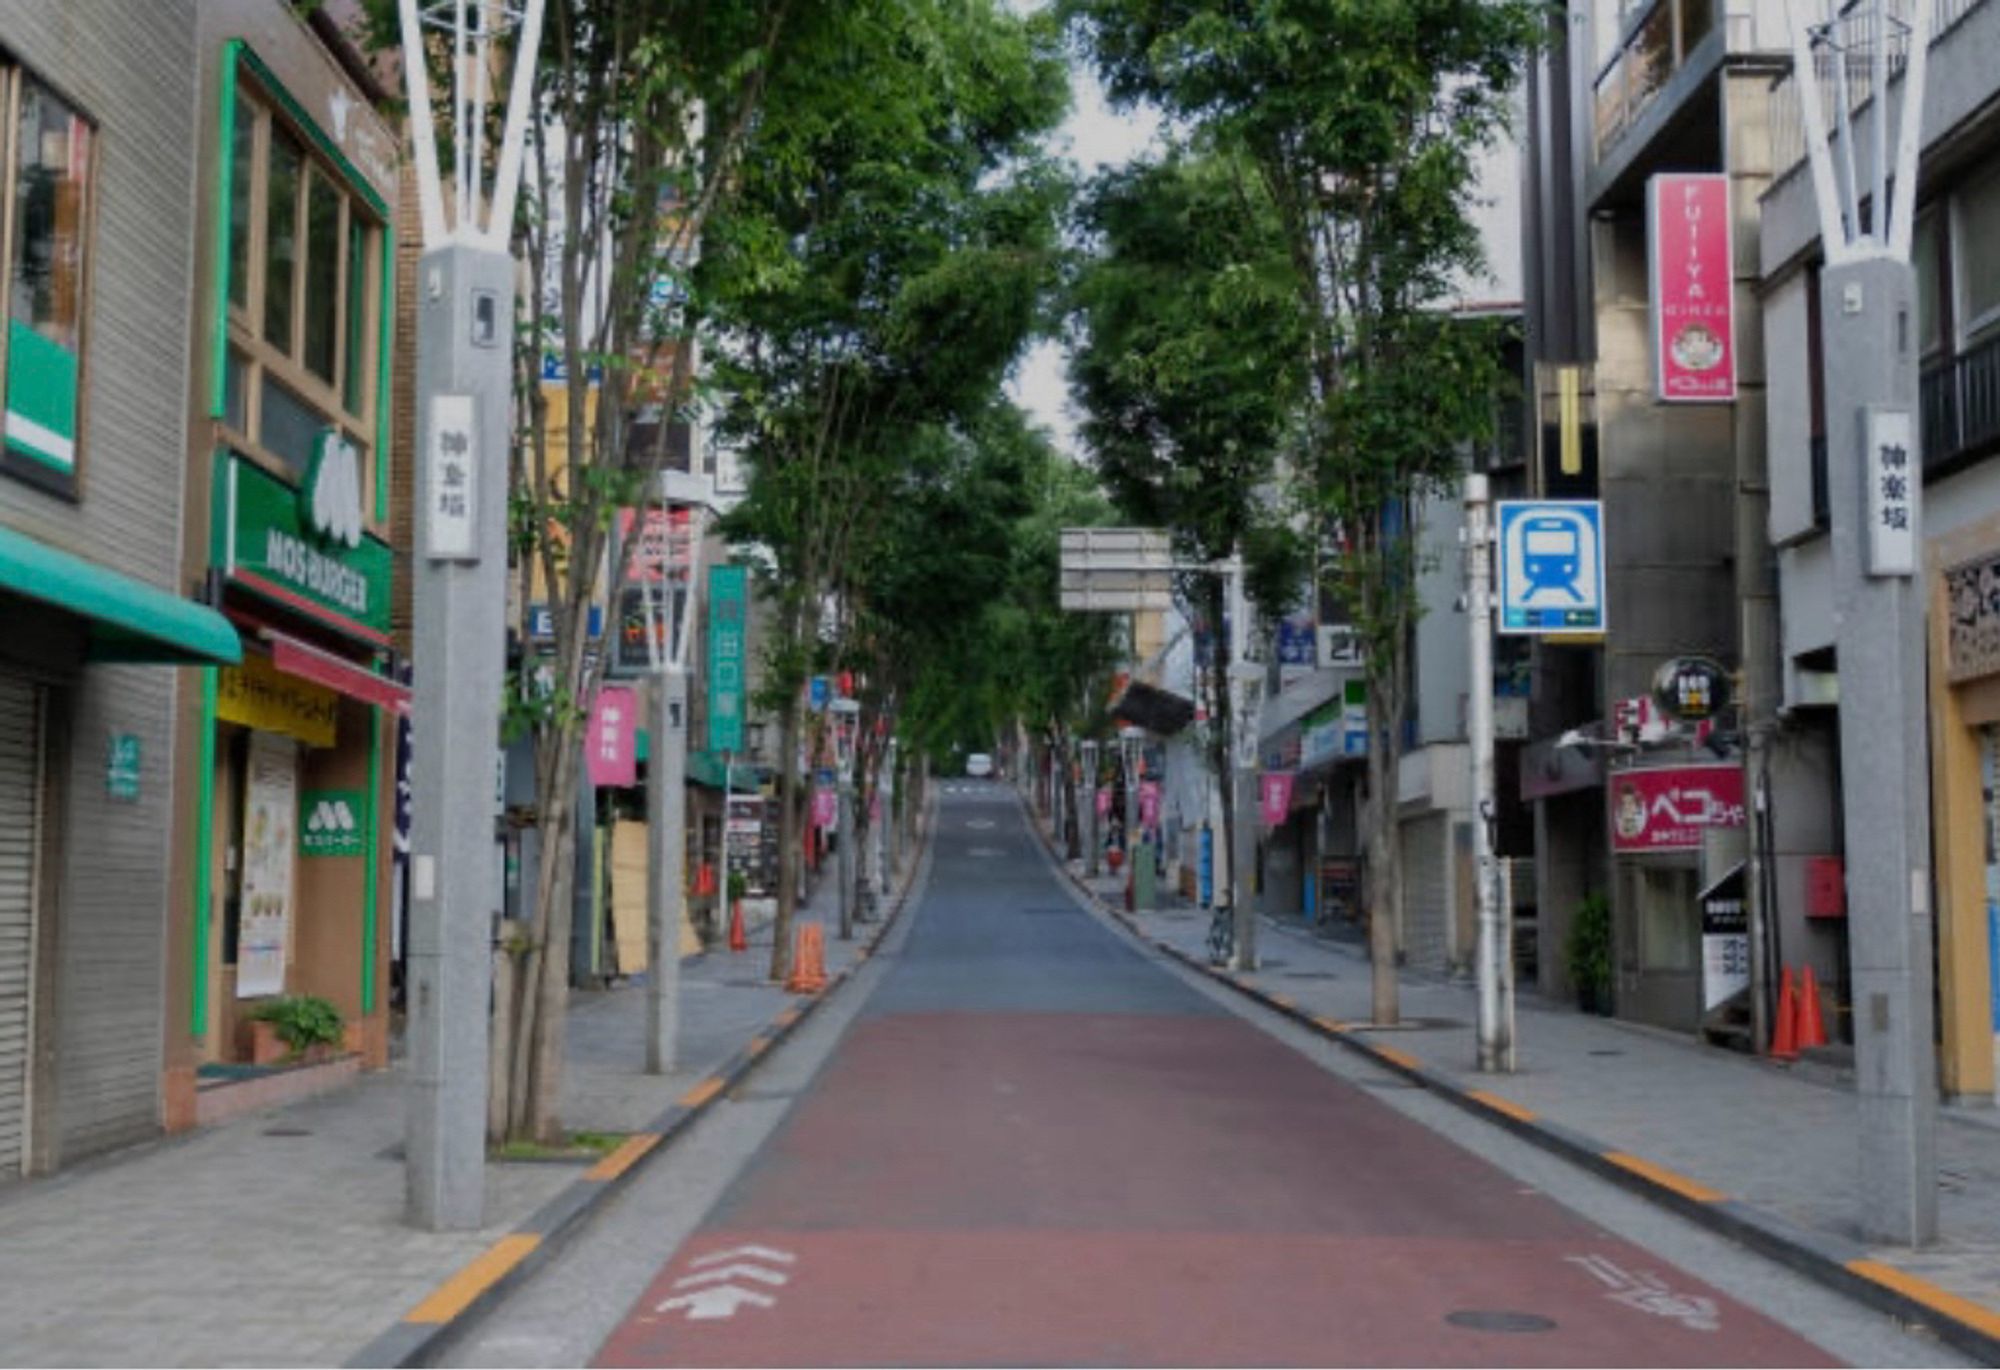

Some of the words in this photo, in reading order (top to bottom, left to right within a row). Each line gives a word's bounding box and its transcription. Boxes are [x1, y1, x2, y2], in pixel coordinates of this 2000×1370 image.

[1880, 443, 1907, 530] 神楽坂
[267, 527, 307, 586] MOS
[308, 549, 367, 614] BURGER
